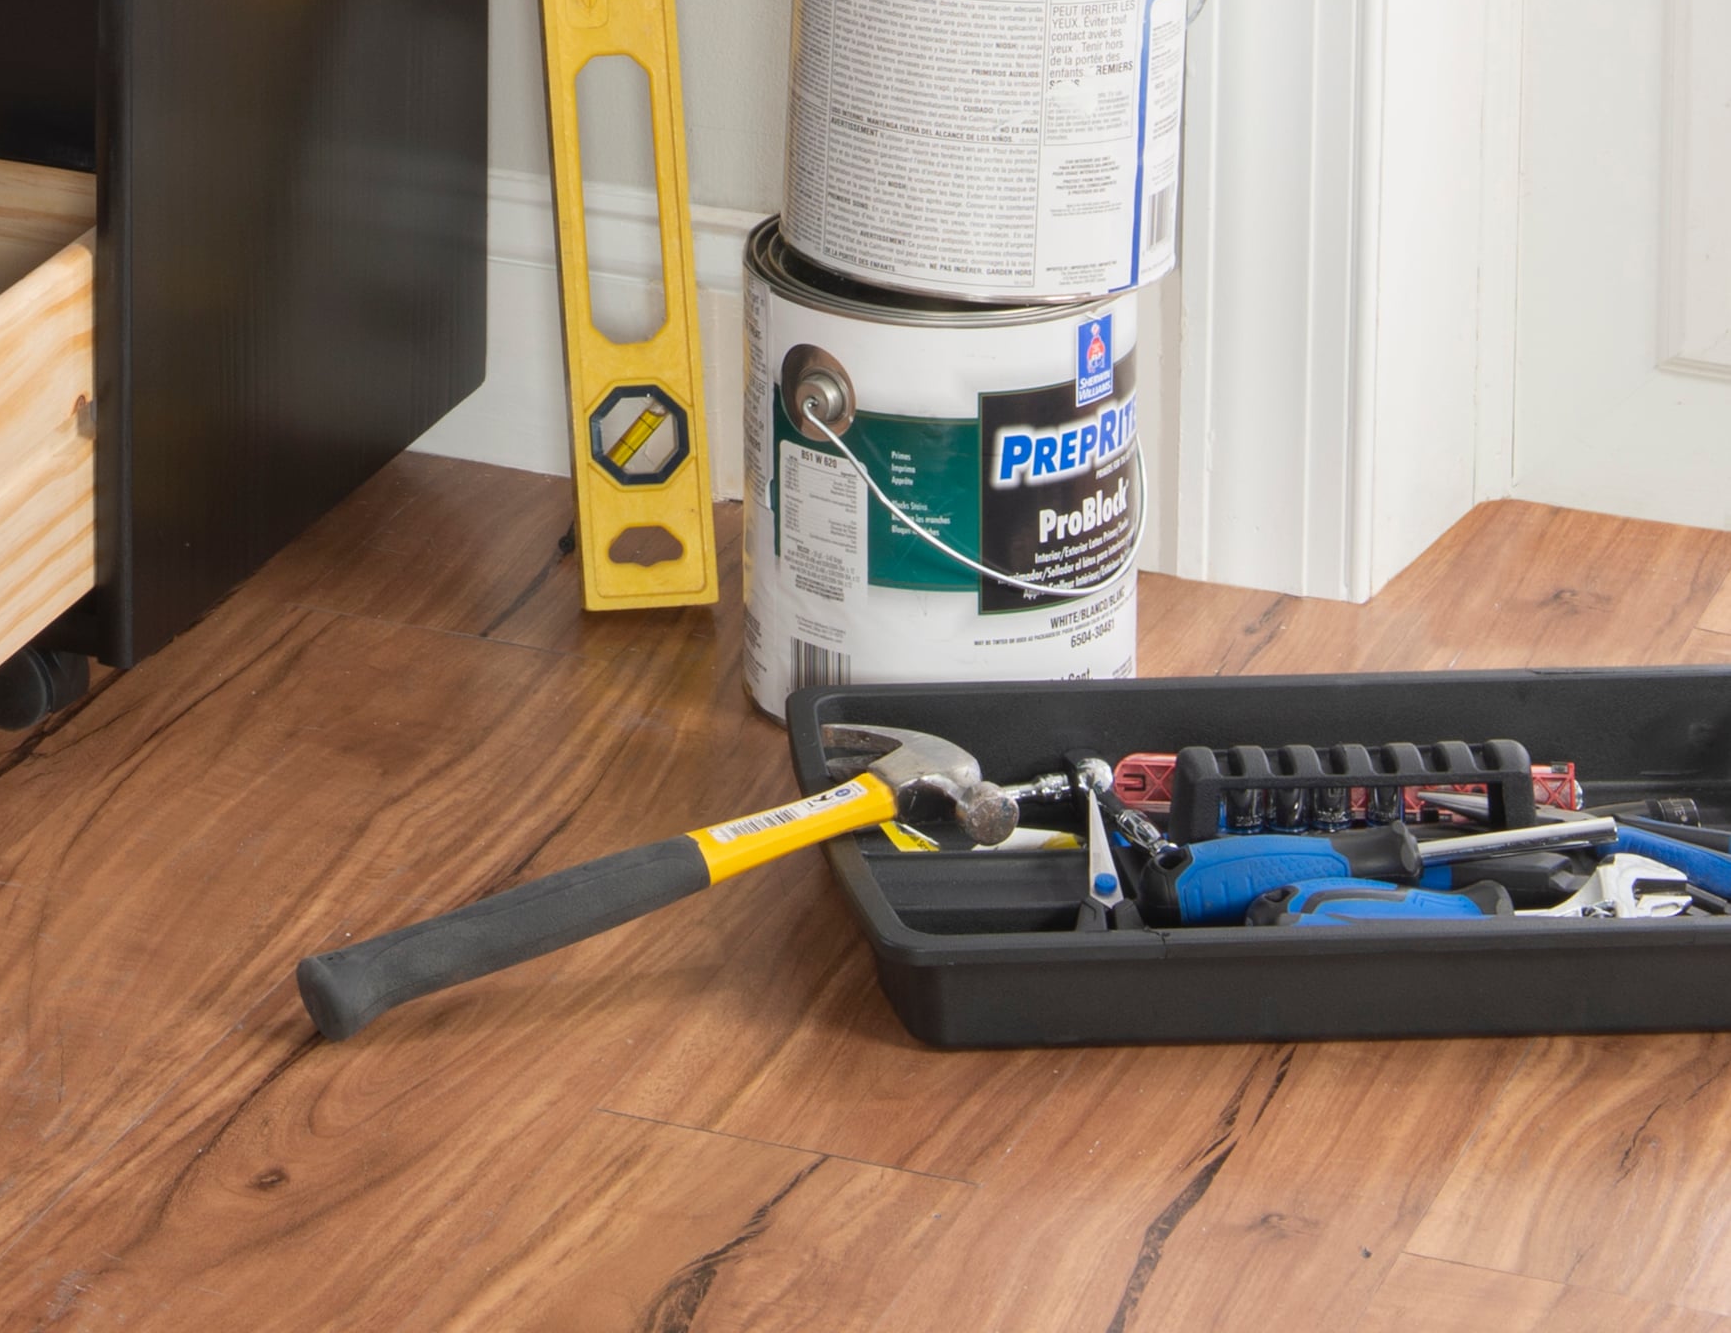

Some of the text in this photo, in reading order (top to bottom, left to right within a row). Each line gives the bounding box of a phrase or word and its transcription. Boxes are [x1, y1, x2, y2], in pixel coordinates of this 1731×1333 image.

[1052, 0, 1135, 17] PEUT IRRITER LES
[1110, 14, 1127, 25] tout
[1051, 28, 1122, 42] contact avec les
[1081, 41, 1103, 53] Tenir
[1105, 39, 1124, 50] hors
[1050, 55, 1062, 66] de
[1064, 55, 1072, 65] la
[1106, 52, 1120, 63] des
[1096, 61, 1134, 75] REMIERS
[1079, 370, 1111, 390] SHERWIN
[1078, 381, 1111, 402] WILLIAMS
[1039, 477, 1128, 543] ProBlock
